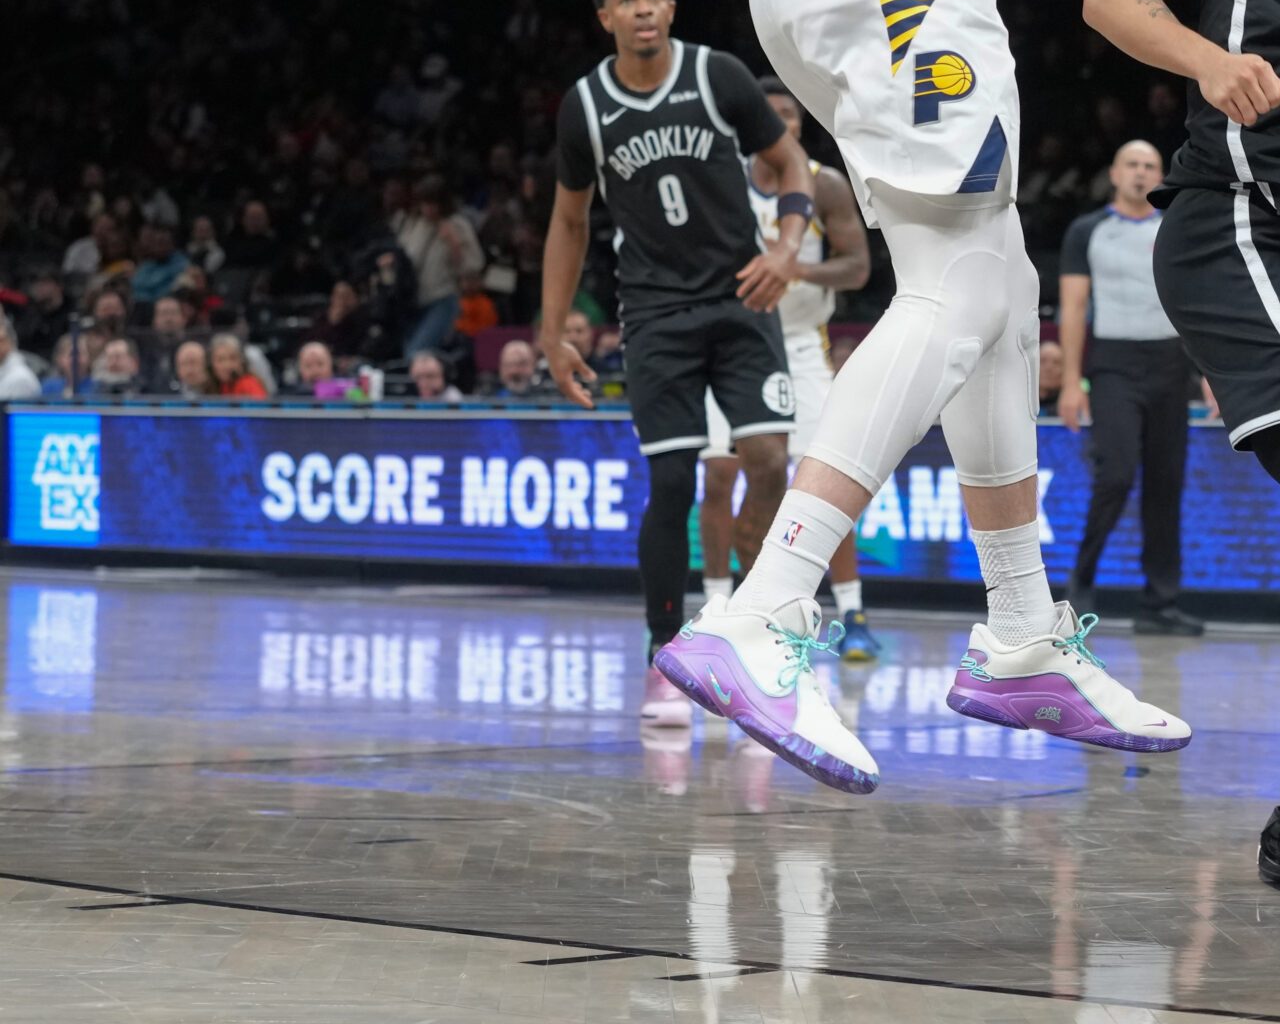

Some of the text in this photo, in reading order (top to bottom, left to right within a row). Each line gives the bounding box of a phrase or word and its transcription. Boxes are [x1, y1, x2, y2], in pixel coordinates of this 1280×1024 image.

[608, 125, 715, 181] BROOKLYN
[657, 174, 689, 227] 9
[261, 452, 445, 525] SCORE
[460, 456, 629, 532] MORE
